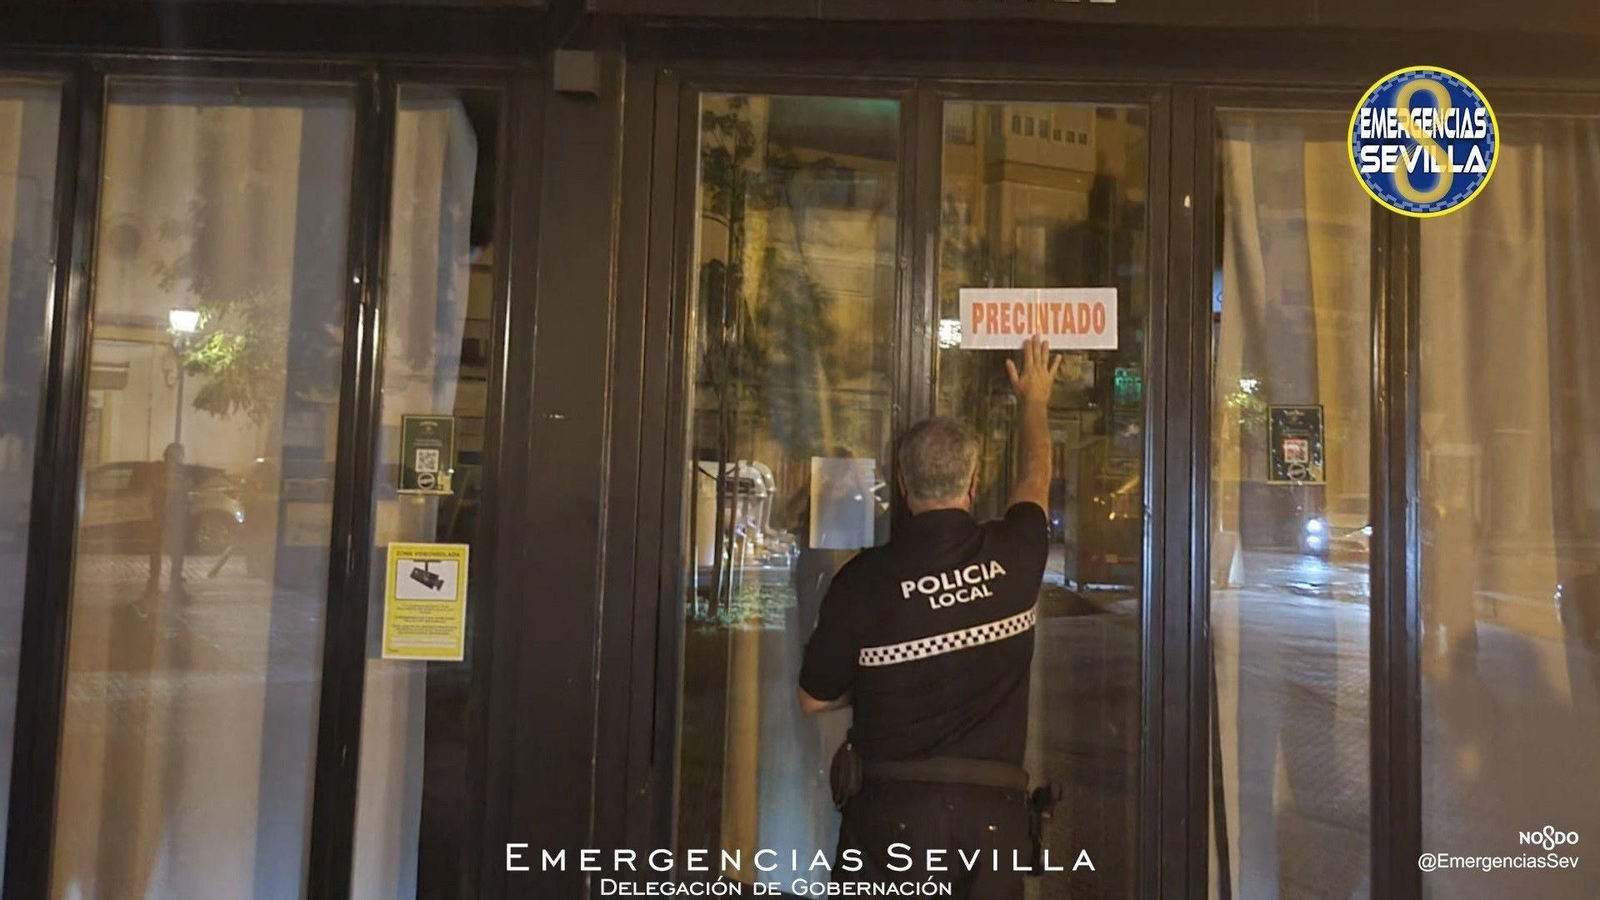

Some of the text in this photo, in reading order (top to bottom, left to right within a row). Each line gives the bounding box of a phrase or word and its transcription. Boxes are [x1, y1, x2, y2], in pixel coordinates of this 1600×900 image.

[971, 302, 1106, 335] PRECINTADO
[900, 560, 1006, 599] POLICIA
[929, 584, 993, 610] LOCAL
